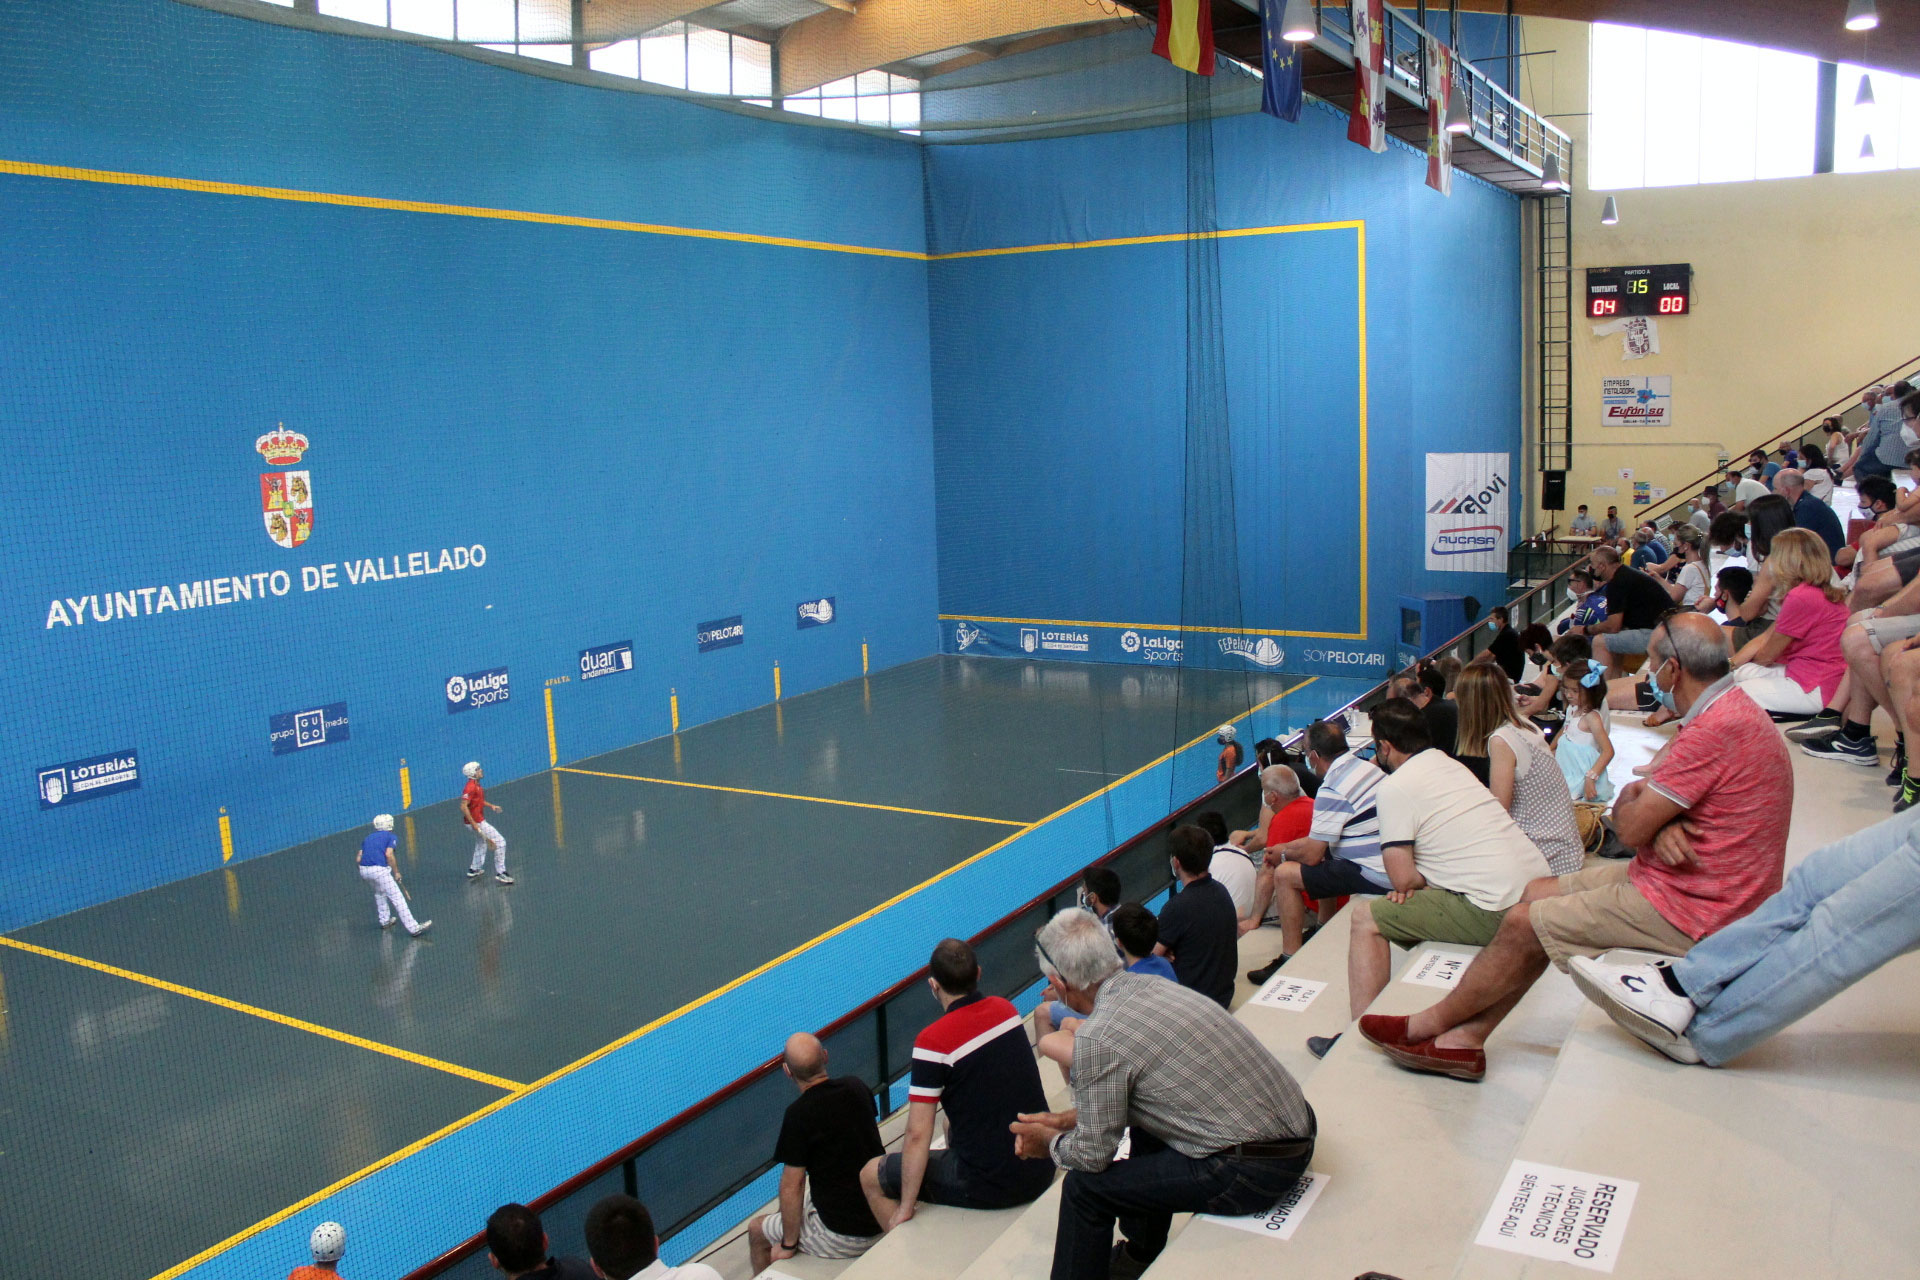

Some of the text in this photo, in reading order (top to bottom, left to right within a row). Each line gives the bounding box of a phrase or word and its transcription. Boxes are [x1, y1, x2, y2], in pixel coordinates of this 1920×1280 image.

[1591, 285, 1618, 294] VISITANTE
[1632, 279, 1648, 294] 15
[1663, 283, 1680, 291] LOCAL
[1593, 299, 1616, 315] 04
[1660, 297, 1683, 313] 00
[1438, 535, 1496, 545] AUCASA
[46, 544, 487, 630] AYUNTAMIENTO DE VALLELADO
[1041, 632, 1089, 642] LOTERÍAS
[1142, 636, 1184, 650] LaLiga
[581, 651, 615, 672] duar
[1143, 649, 1184, 662] Sports
[581, 666, 615, 680] andamios
[469, 673, 508, 692] LaLiga
[470, 687, 509, 708] Sports
[270, 729, 295, 742] grupo
[71, 757, 136, 780] LOTERÍAS
[219, 806, 227, 814] 6
[1435, 971, 1454, 980] 17
[1277, 994, 1293, 1002] 16
[1265, 1175, 1314, 1231] RESERVADO
[1498, 1173, 1538, 1239] SIÉNTESE AQUÍ
[1530, 1184, 1566, 1239] Y TÉCNICOS
[1552, 1185, 1588, 1245] JUGADORES
[1573, 1182, 1618, 1260] RESERVADO
